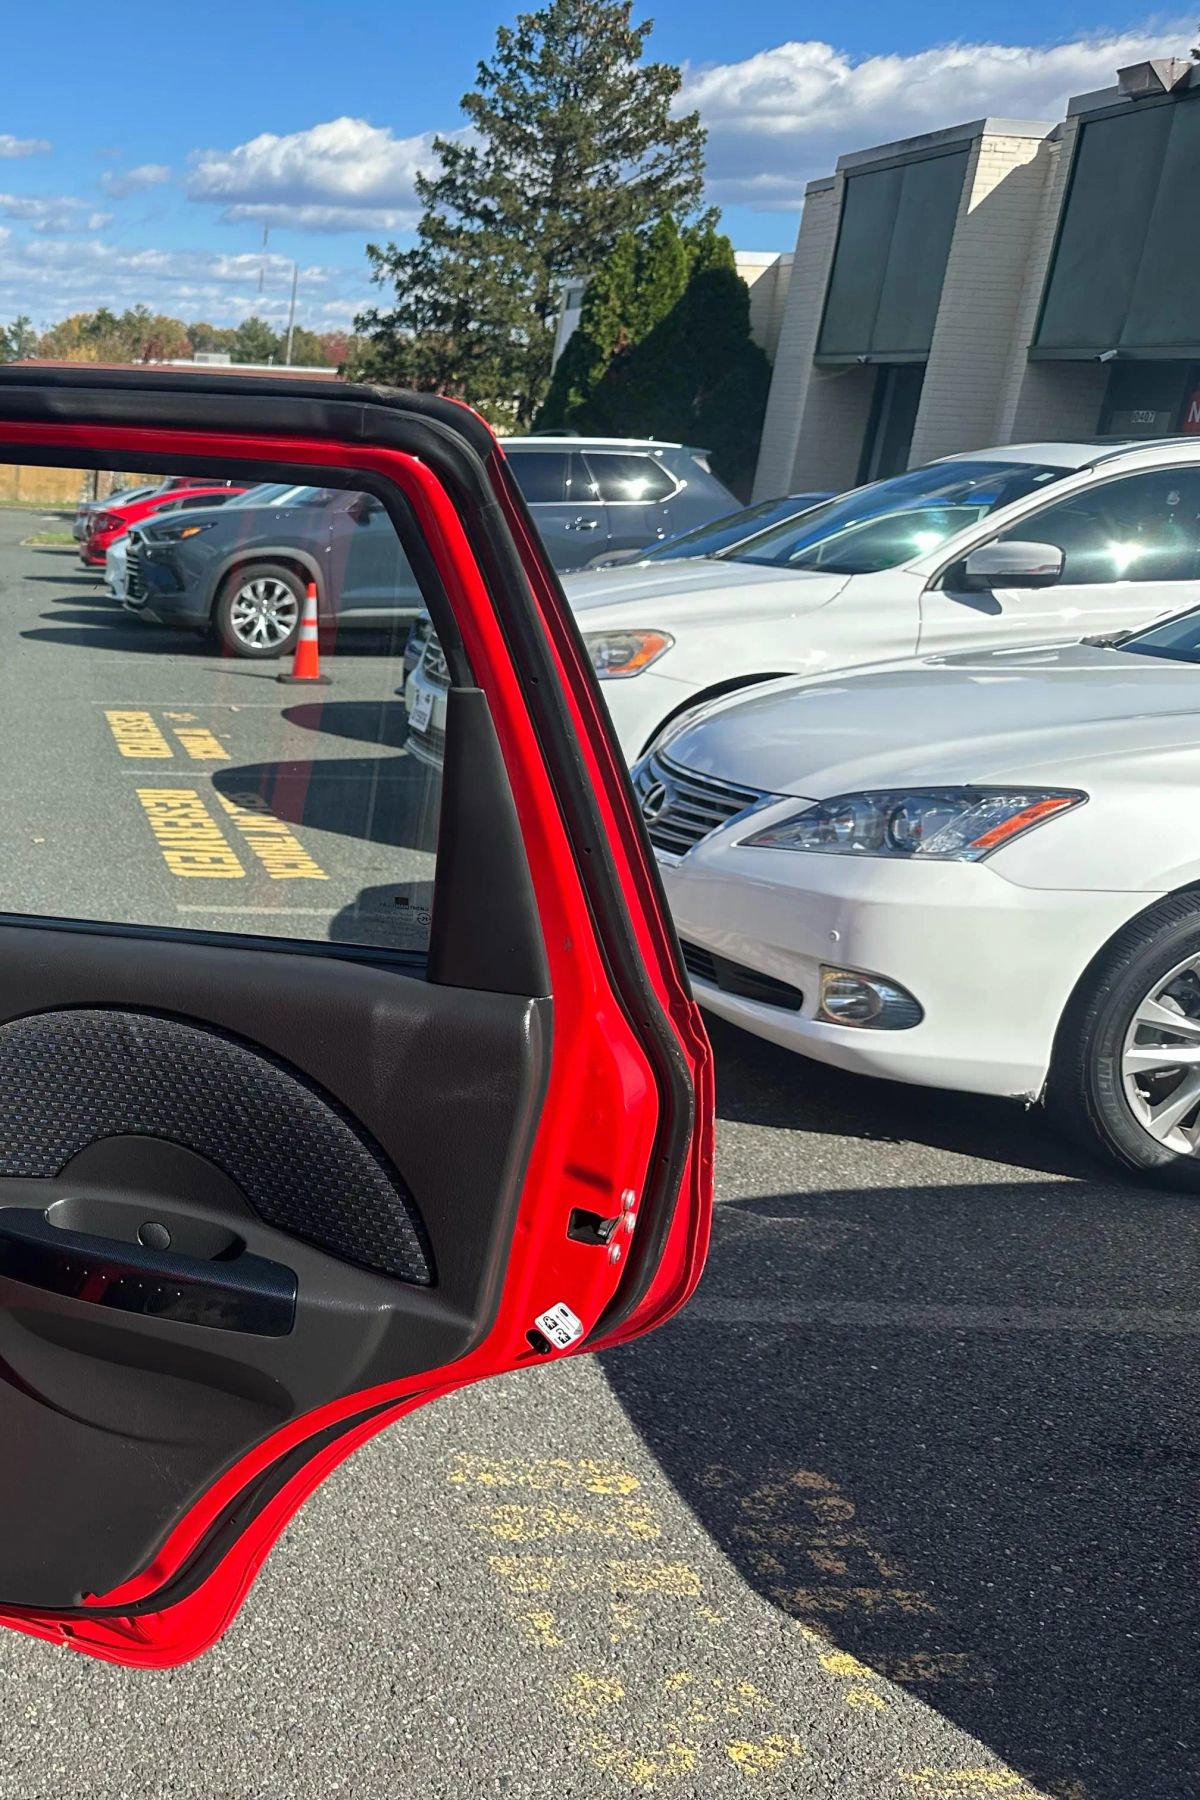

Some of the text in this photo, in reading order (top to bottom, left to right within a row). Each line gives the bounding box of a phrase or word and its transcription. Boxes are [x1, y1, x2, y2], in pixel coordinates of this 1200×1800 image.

[135, 788, 246, 879] RESERVED
[230, 815, 291, 835] MY
[245, 836, 332, 880] TRUCK
